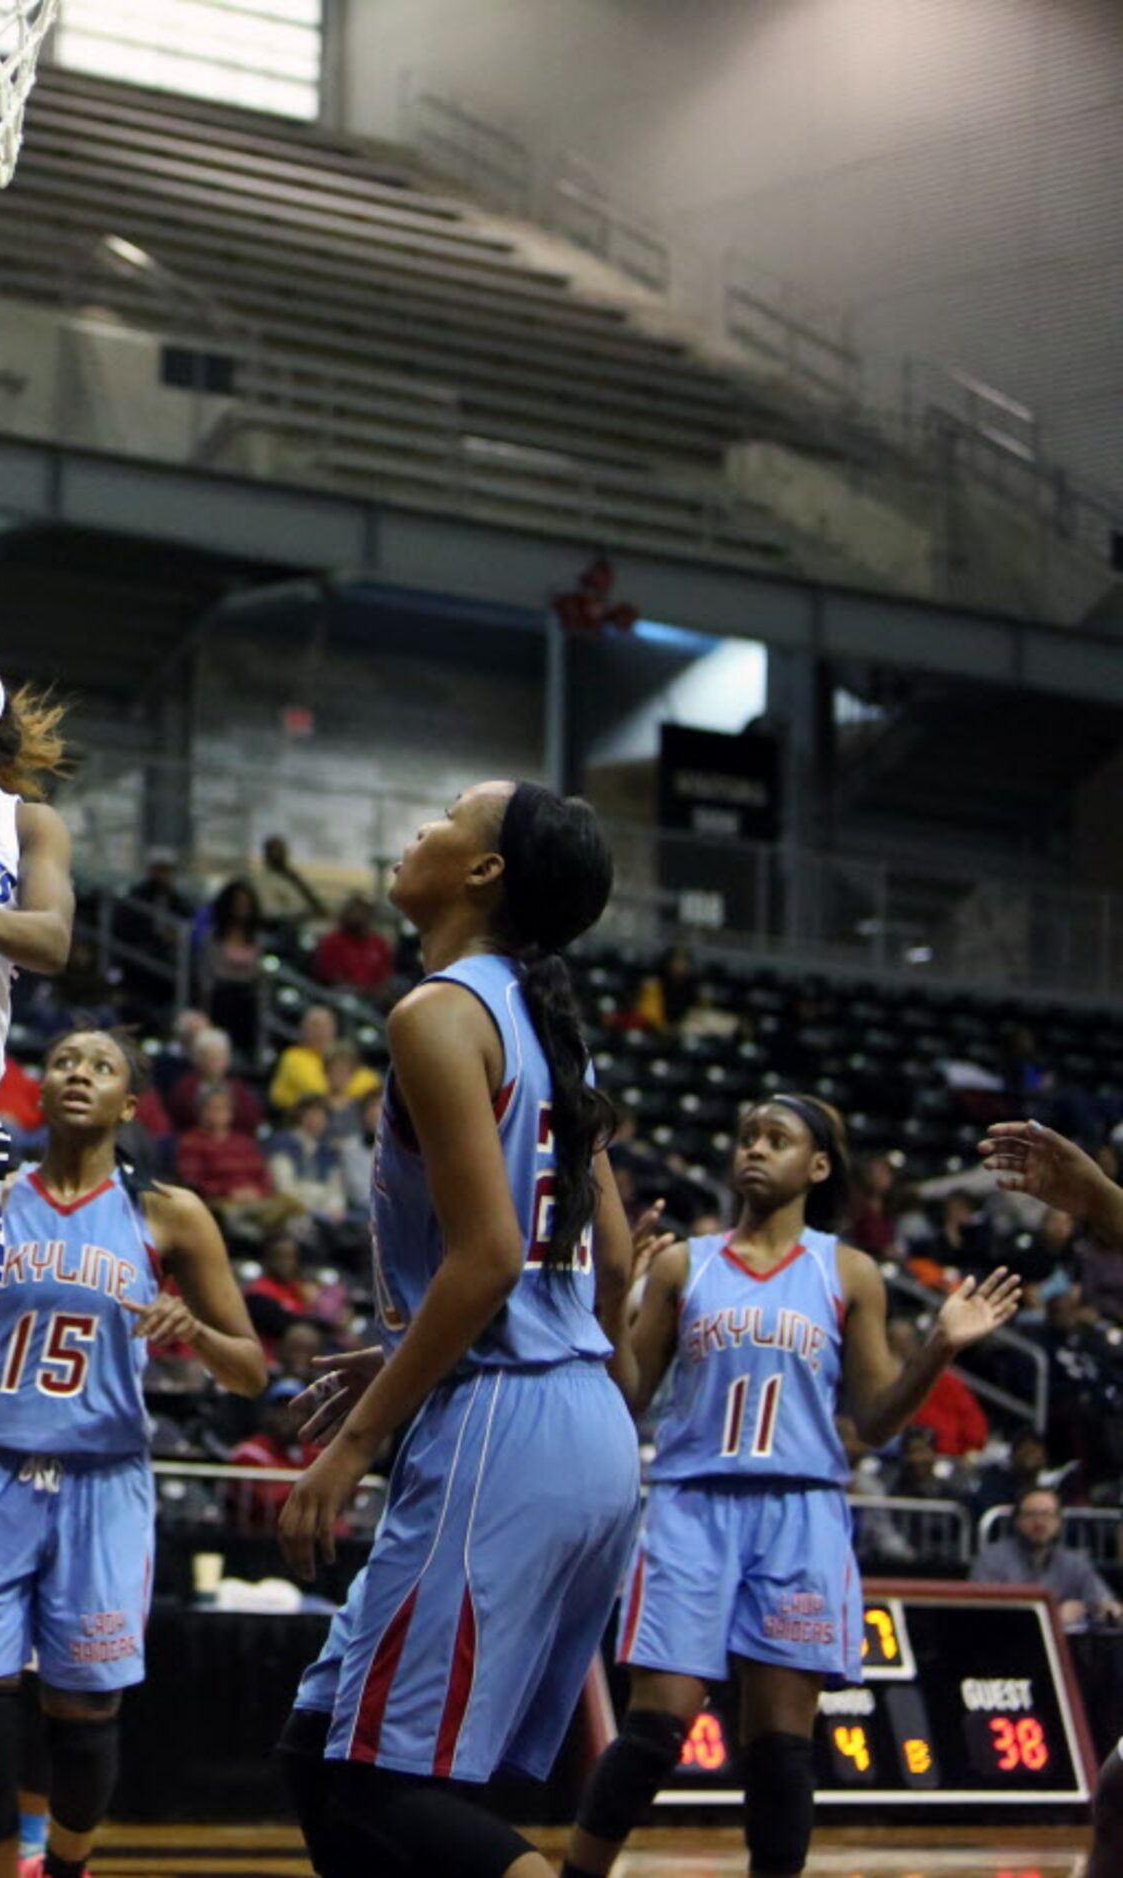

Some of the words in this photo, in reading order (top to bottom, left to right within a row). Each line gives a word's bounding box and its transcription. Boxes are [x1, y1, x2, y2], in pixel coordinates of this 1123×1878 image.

[0, 1240, 138, 1306] KYLINE
[0, 1309, 99, 1397] 15
[690, 1306, 826, 1376] SKYLINE
[719, 1372, 784, 1458] 11
[961, 1678, 1033, 1711] GUEST
[833, 1726, 870, 1772] 4
[989, 1717, 1048, 1771] 38
